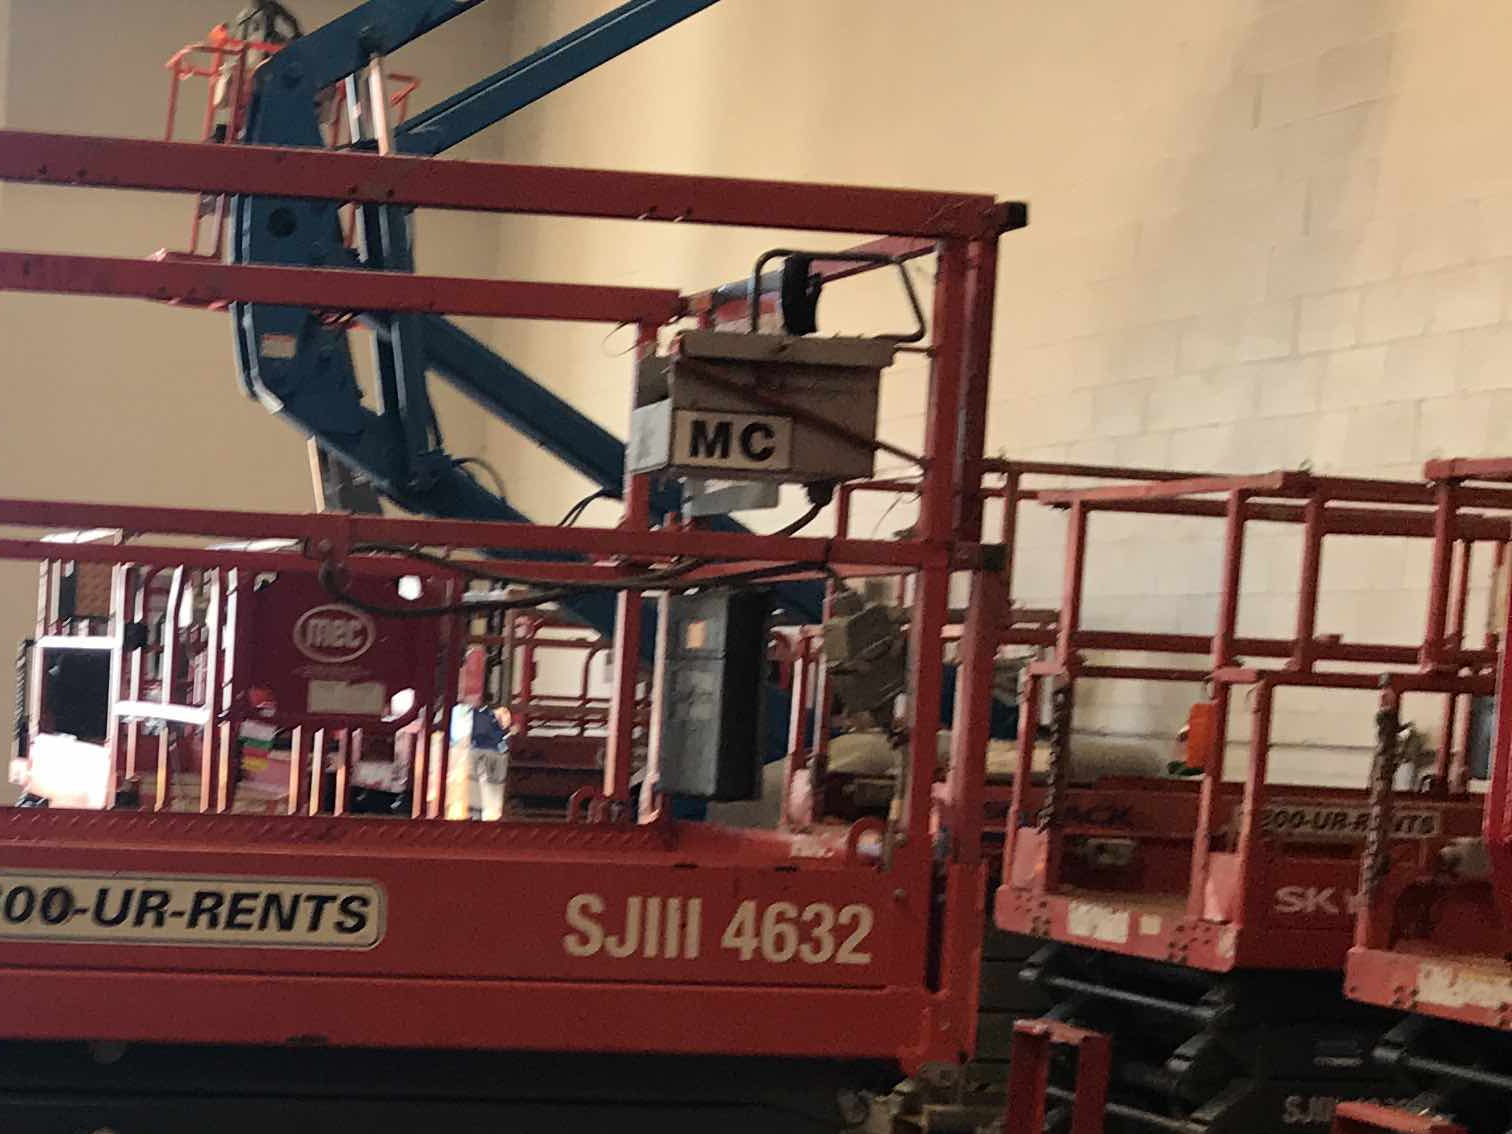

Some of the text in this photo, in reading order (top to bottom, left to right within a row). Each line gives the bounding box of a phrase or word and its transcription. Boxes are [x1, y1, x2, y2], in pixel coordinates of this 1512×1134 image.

[689, 419, 776, 462] MC
[563, 893, 875, 965] SJIII 4632
